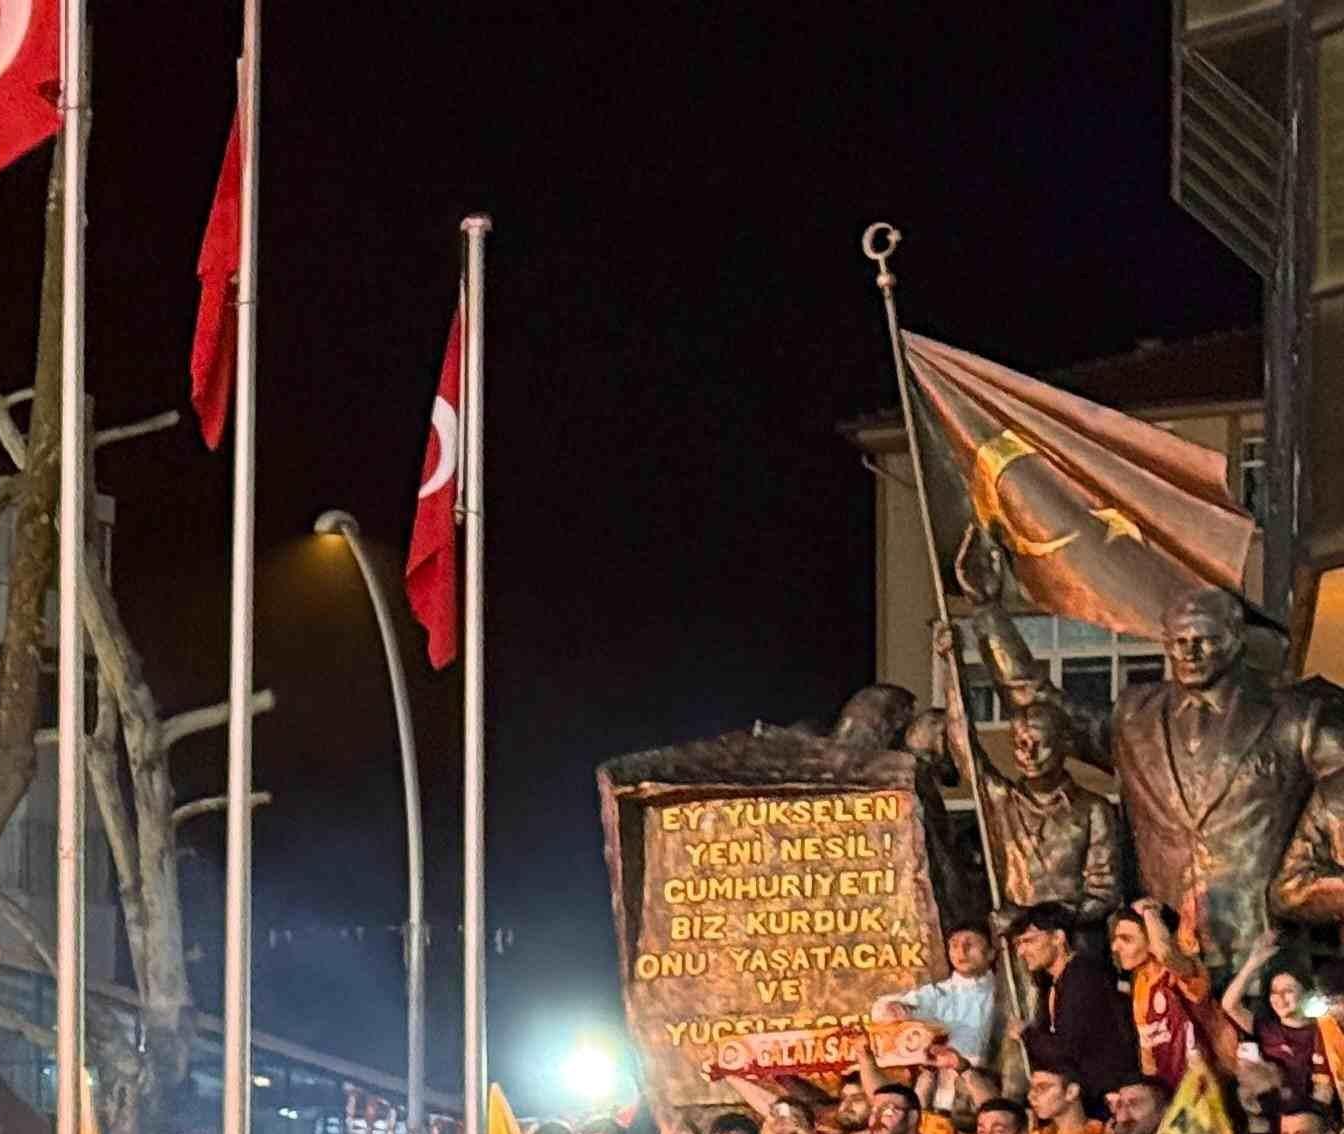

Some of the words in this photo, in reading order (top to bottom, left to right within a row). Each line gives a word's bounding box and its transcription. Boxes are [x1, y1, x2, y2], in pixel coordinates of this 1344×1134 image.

[662, 804, 705, 832] EY
[685, 832, 762, 866] YENİ
[664, 867, 895, 904] CUMHURİYETİ
[671, 908, 726, 941] BİZ
[636, 952, 707, 980] ONU
[730, 942, 926, 977] YAŞATACAK
[756, 979, 801, 1004] VE
